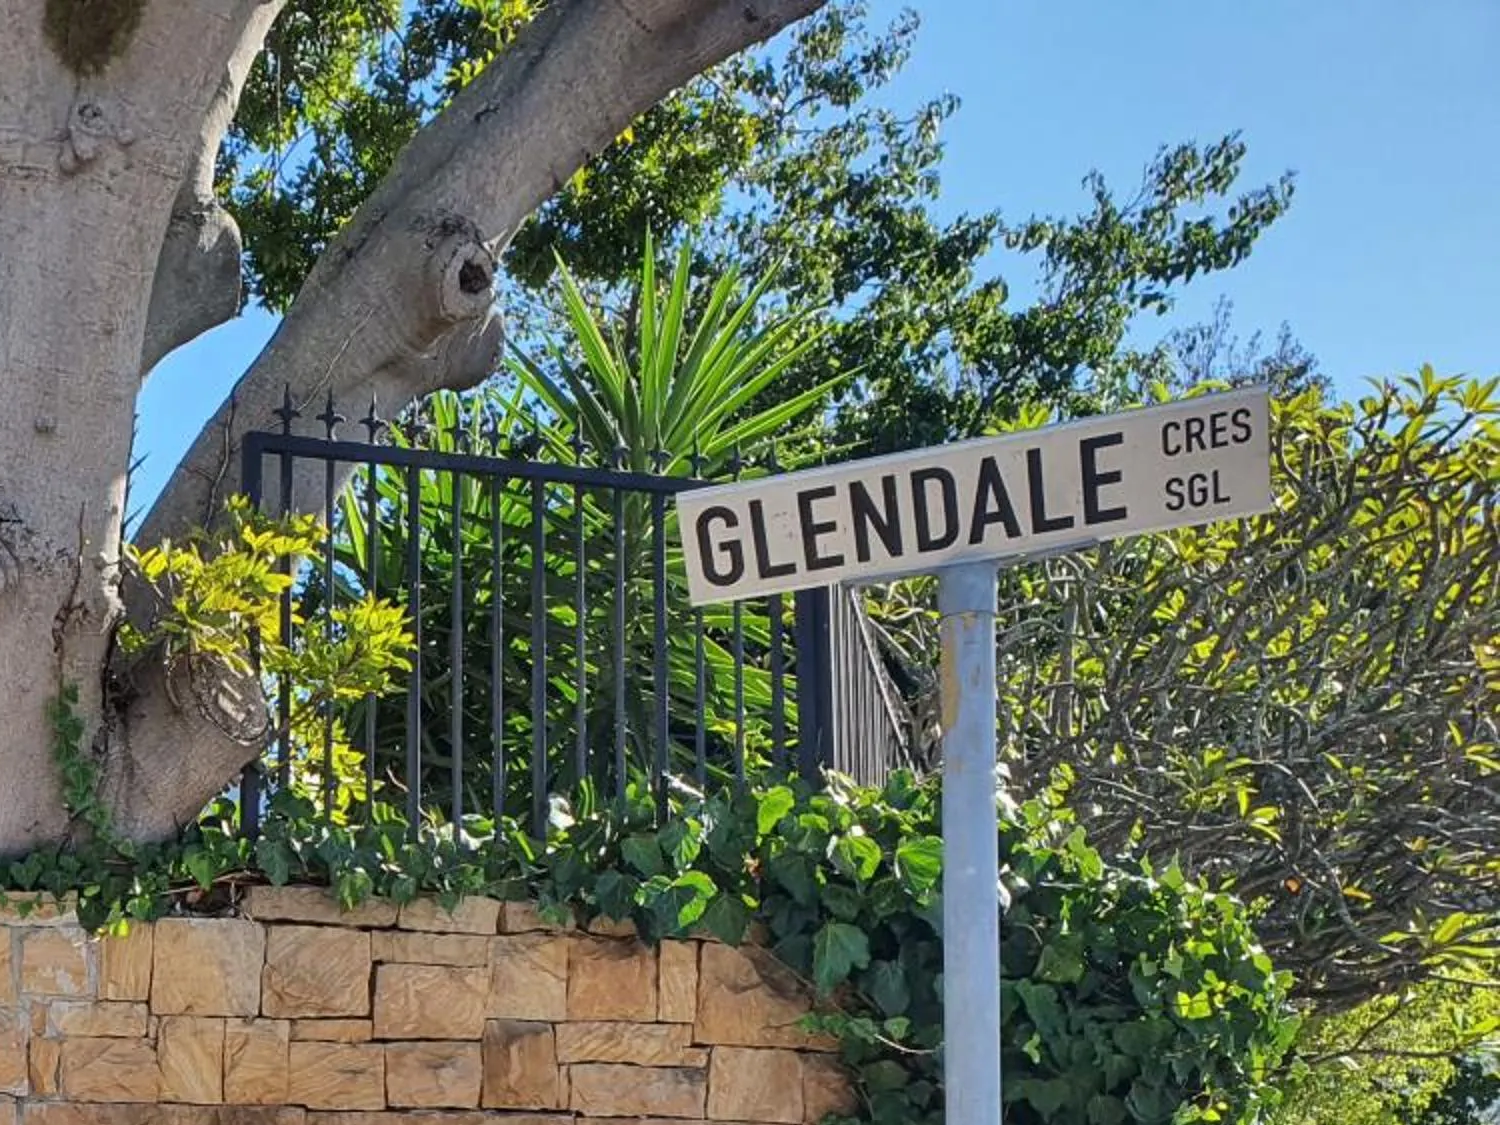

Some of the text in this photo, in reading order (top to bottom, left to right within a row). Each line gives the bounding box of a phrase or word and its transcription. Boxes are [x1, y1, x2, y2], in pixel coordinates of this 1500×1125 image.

[696, 408, 1253, 586] GLENDALE CRES
[1164, 470, 1231, 512] SGL
